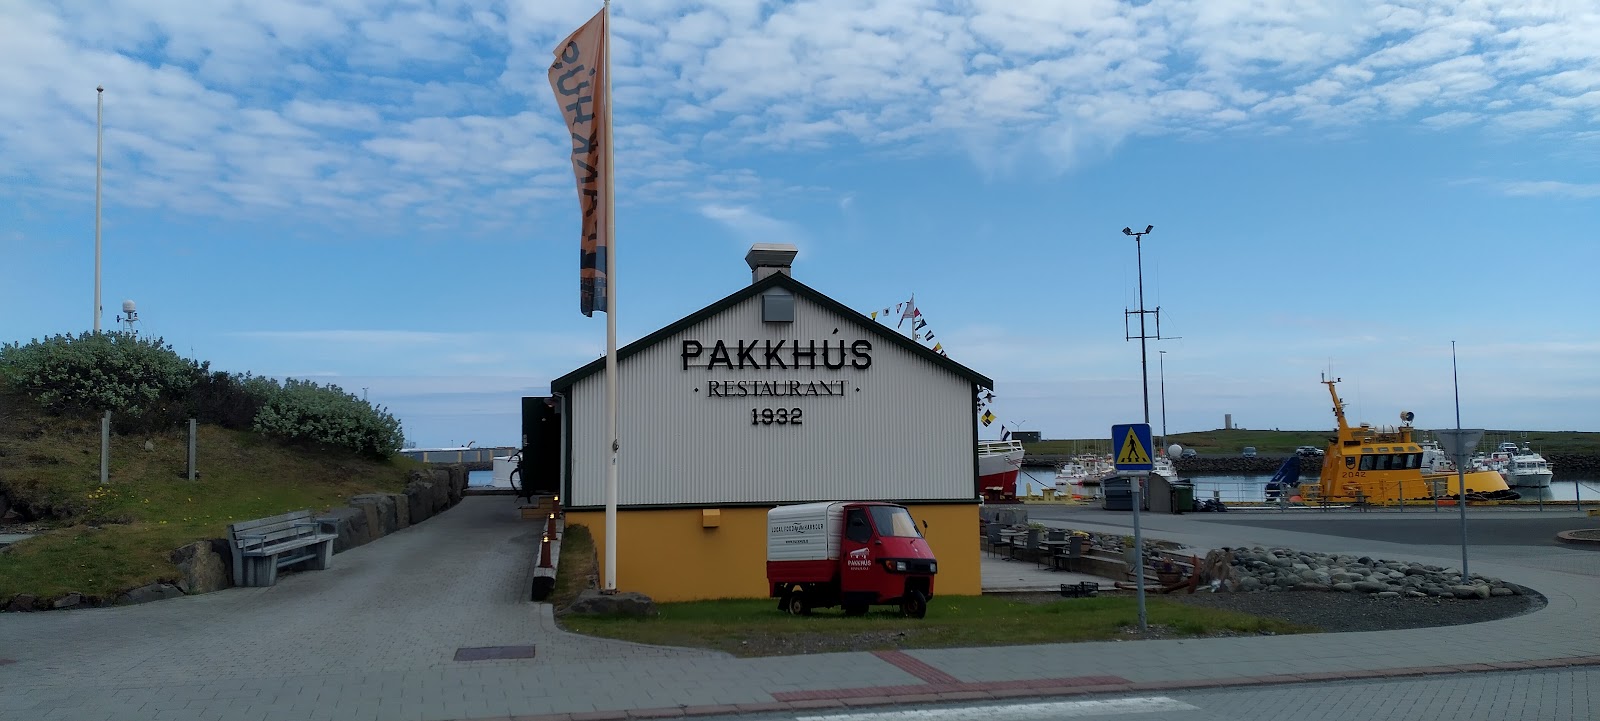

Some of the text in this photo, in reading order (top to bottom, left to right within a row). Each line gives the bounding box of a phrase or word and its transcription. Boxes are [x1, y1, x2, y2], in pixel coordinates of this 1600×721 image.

[681, 327, 873, 370] PAKKHÚS
[707, 380, 849, 397] RESTAURANT
[751, 407, 803, 426] 1932
